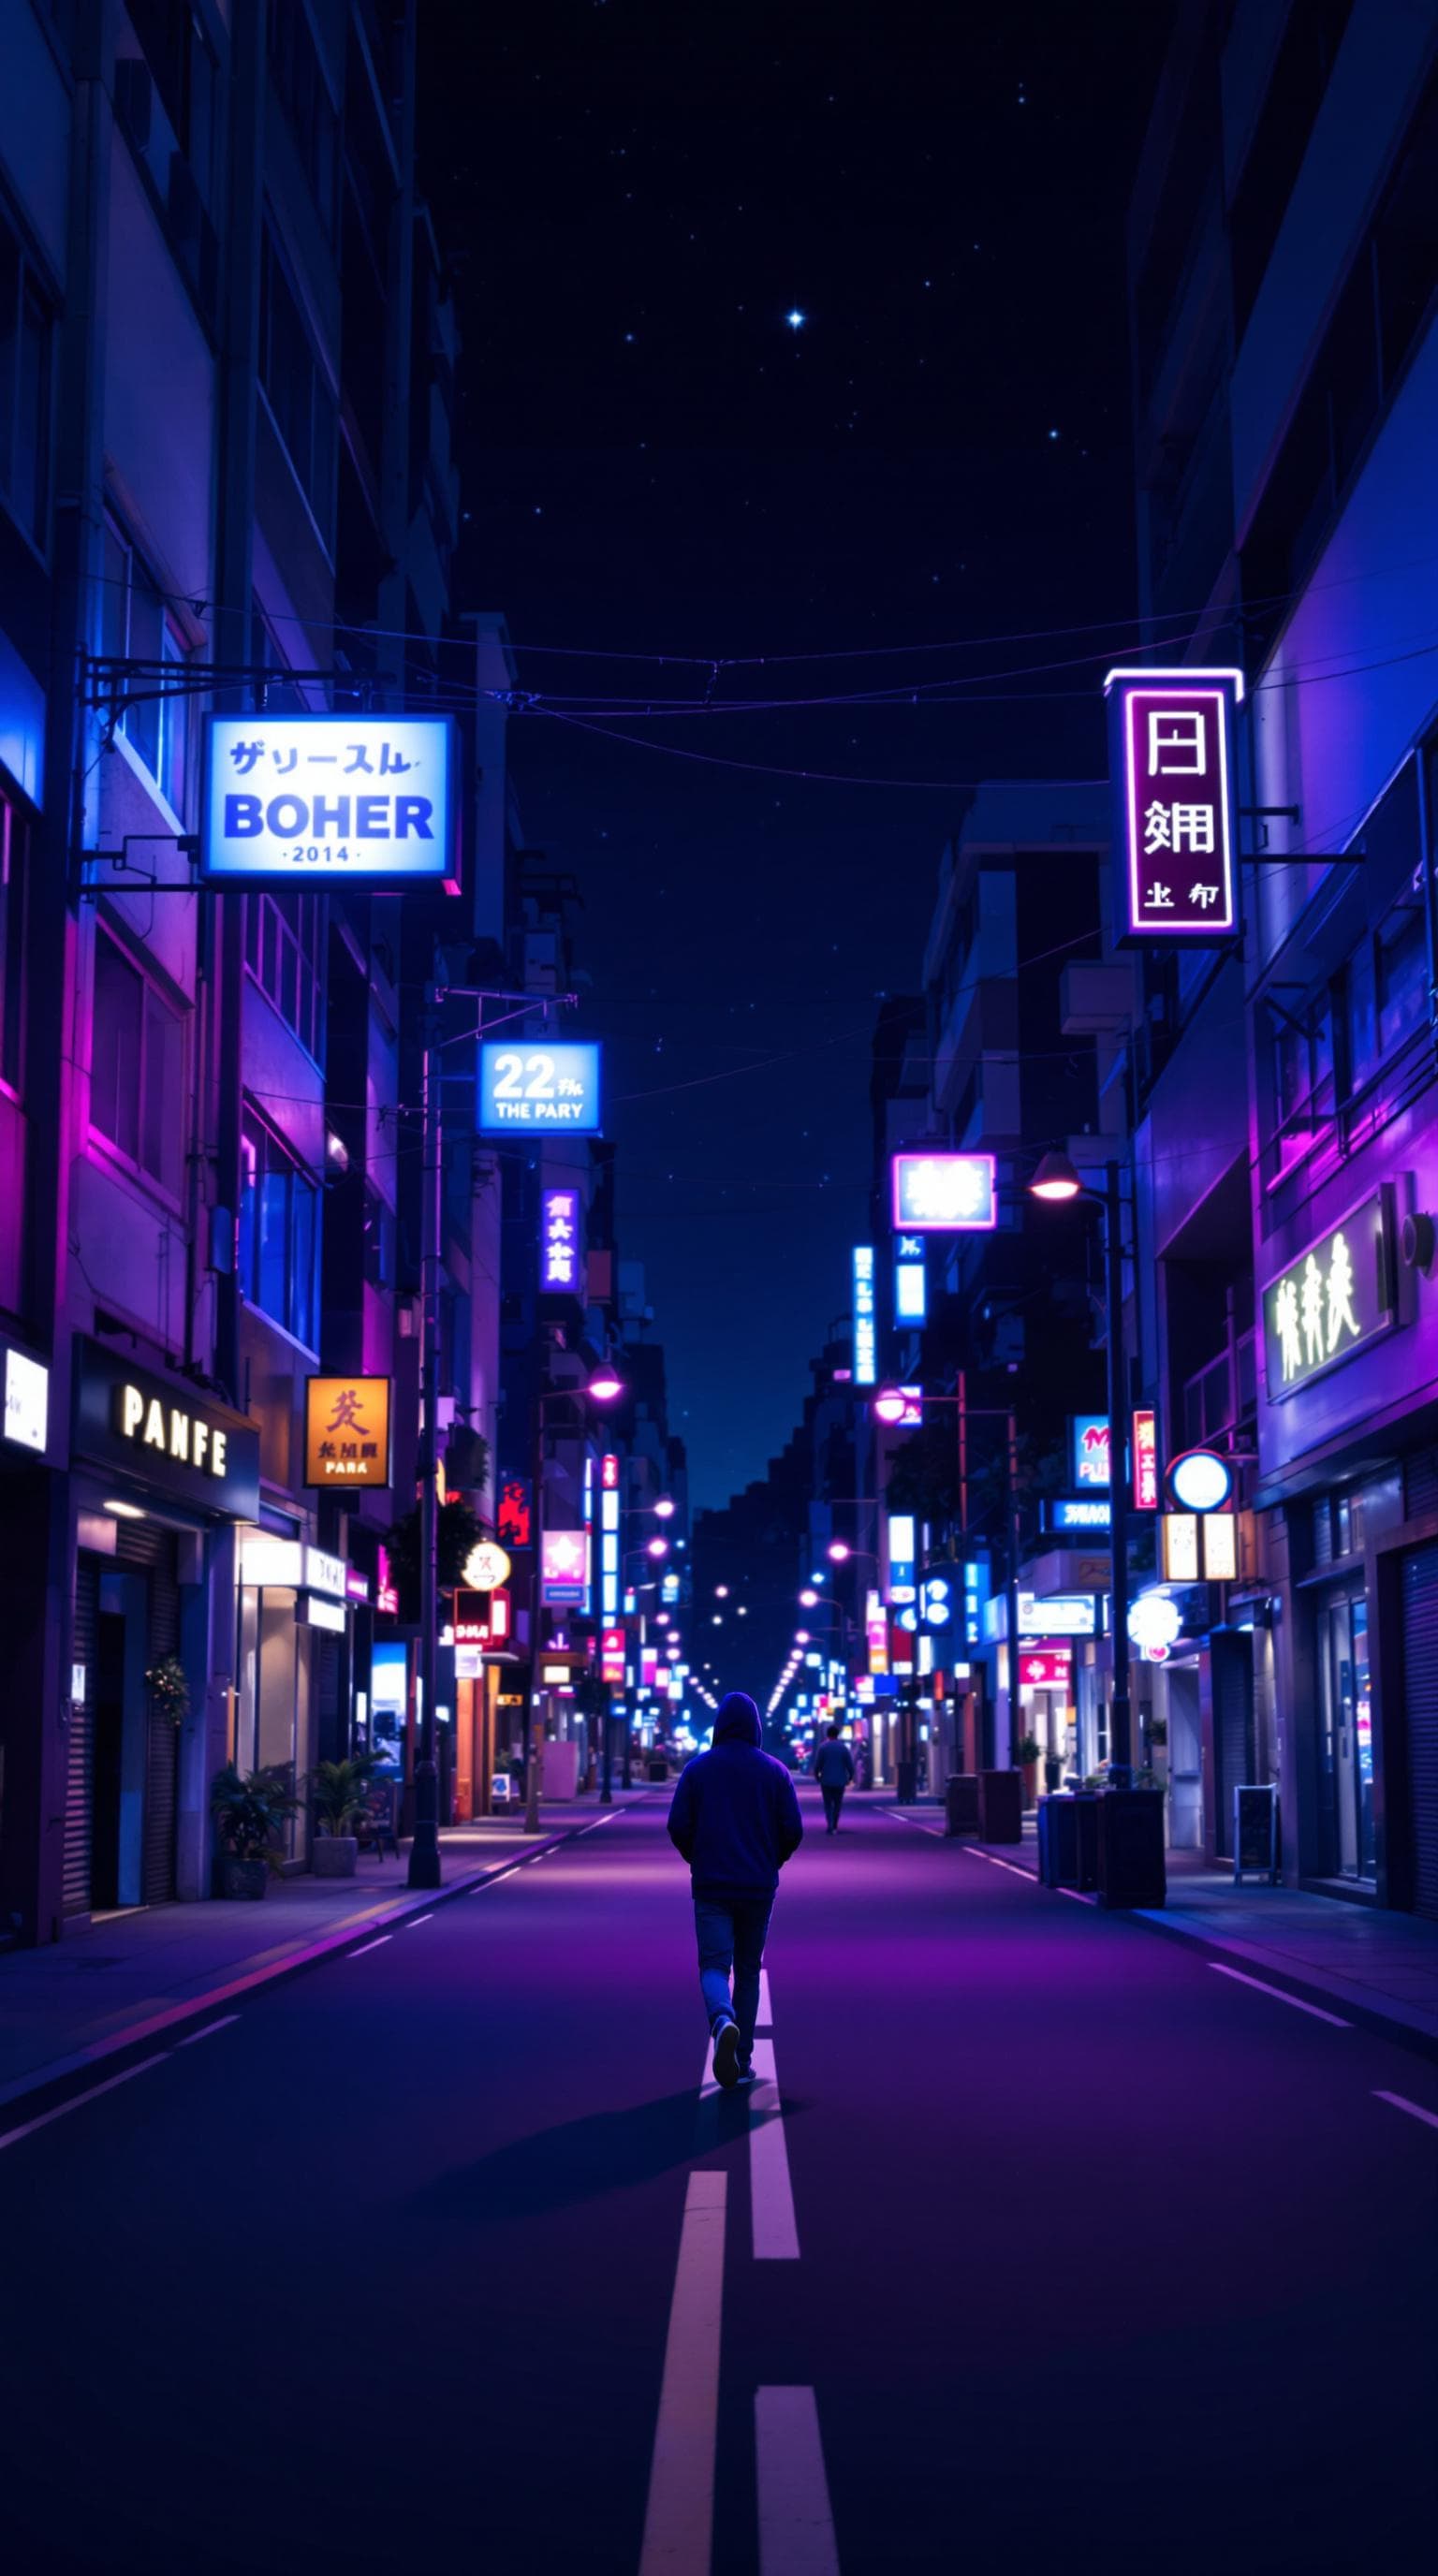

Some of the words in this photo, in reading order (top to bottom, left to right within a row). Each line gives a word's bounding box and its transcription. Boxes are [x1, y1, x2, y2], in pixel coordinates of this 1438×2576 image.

[224, 794, 434, 839] BOHER
[493, 1054, 555, 1098] 22
[496, 1103, 531, 1119] THE
[535, 1103, 582, 1119] PARY
[124, 1384, 227, 1477] PANFE
